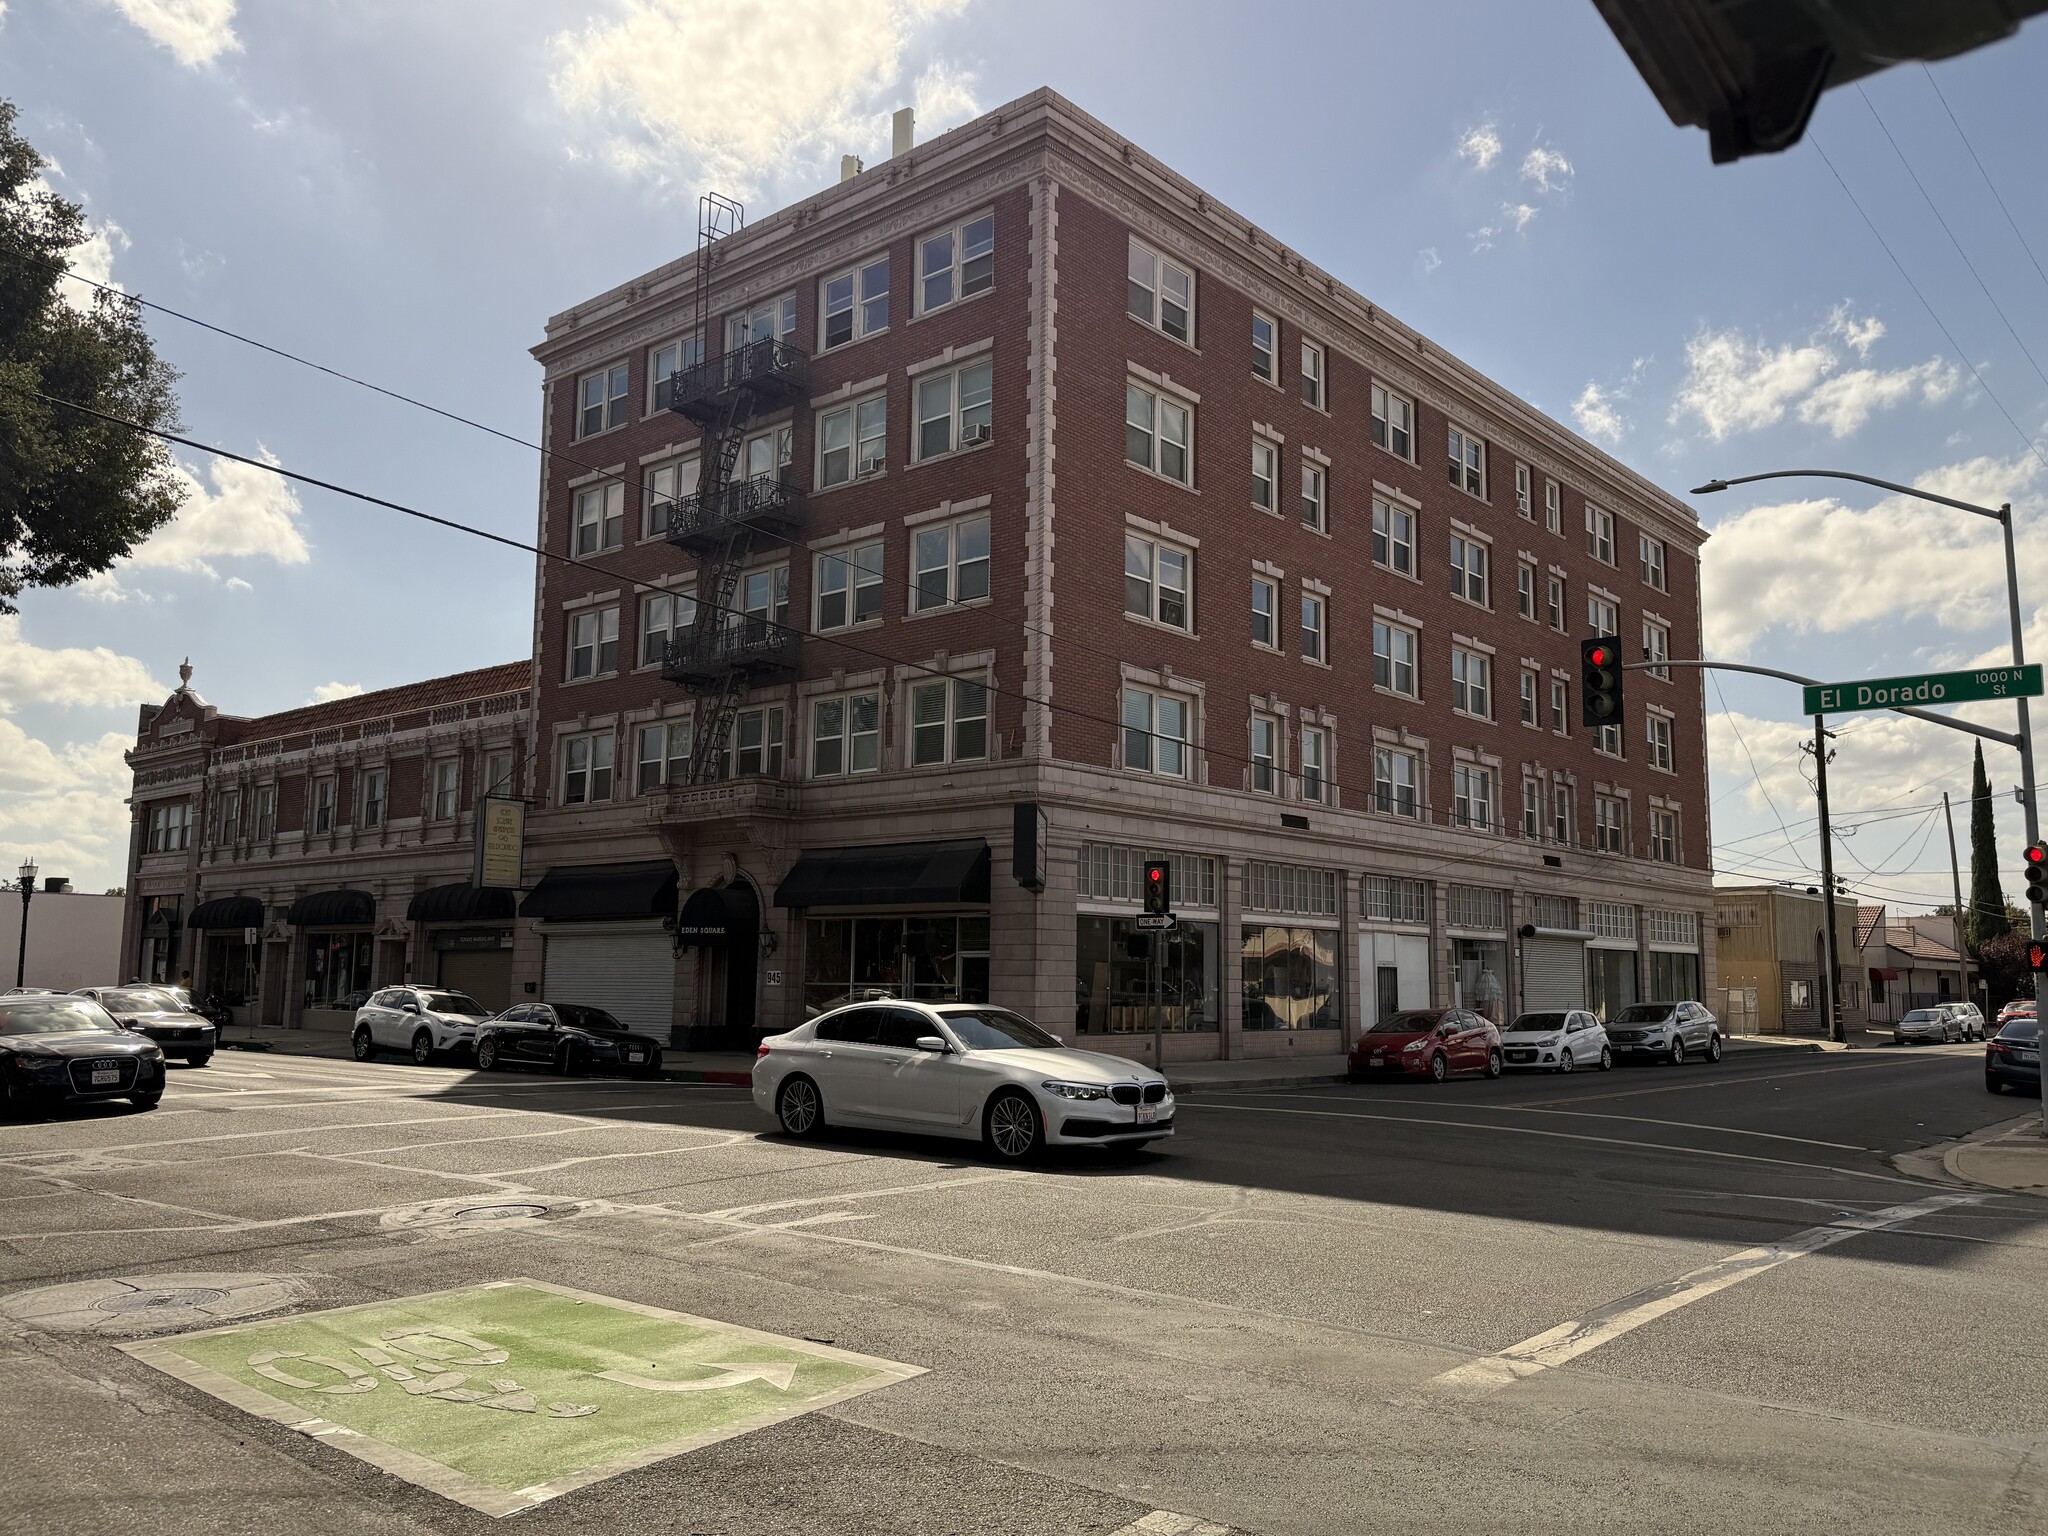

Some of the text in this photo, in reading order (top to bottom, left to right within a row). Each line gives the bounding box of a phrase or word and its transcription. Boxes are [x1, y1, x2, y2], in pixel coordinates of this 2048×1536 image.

[1975, 670, 2023, 684] 1000 N
[1820, 680, 1946, 709] El Dorado
[1992, 684, 2007, 695] St
[767, 972, 780, 983] 945
